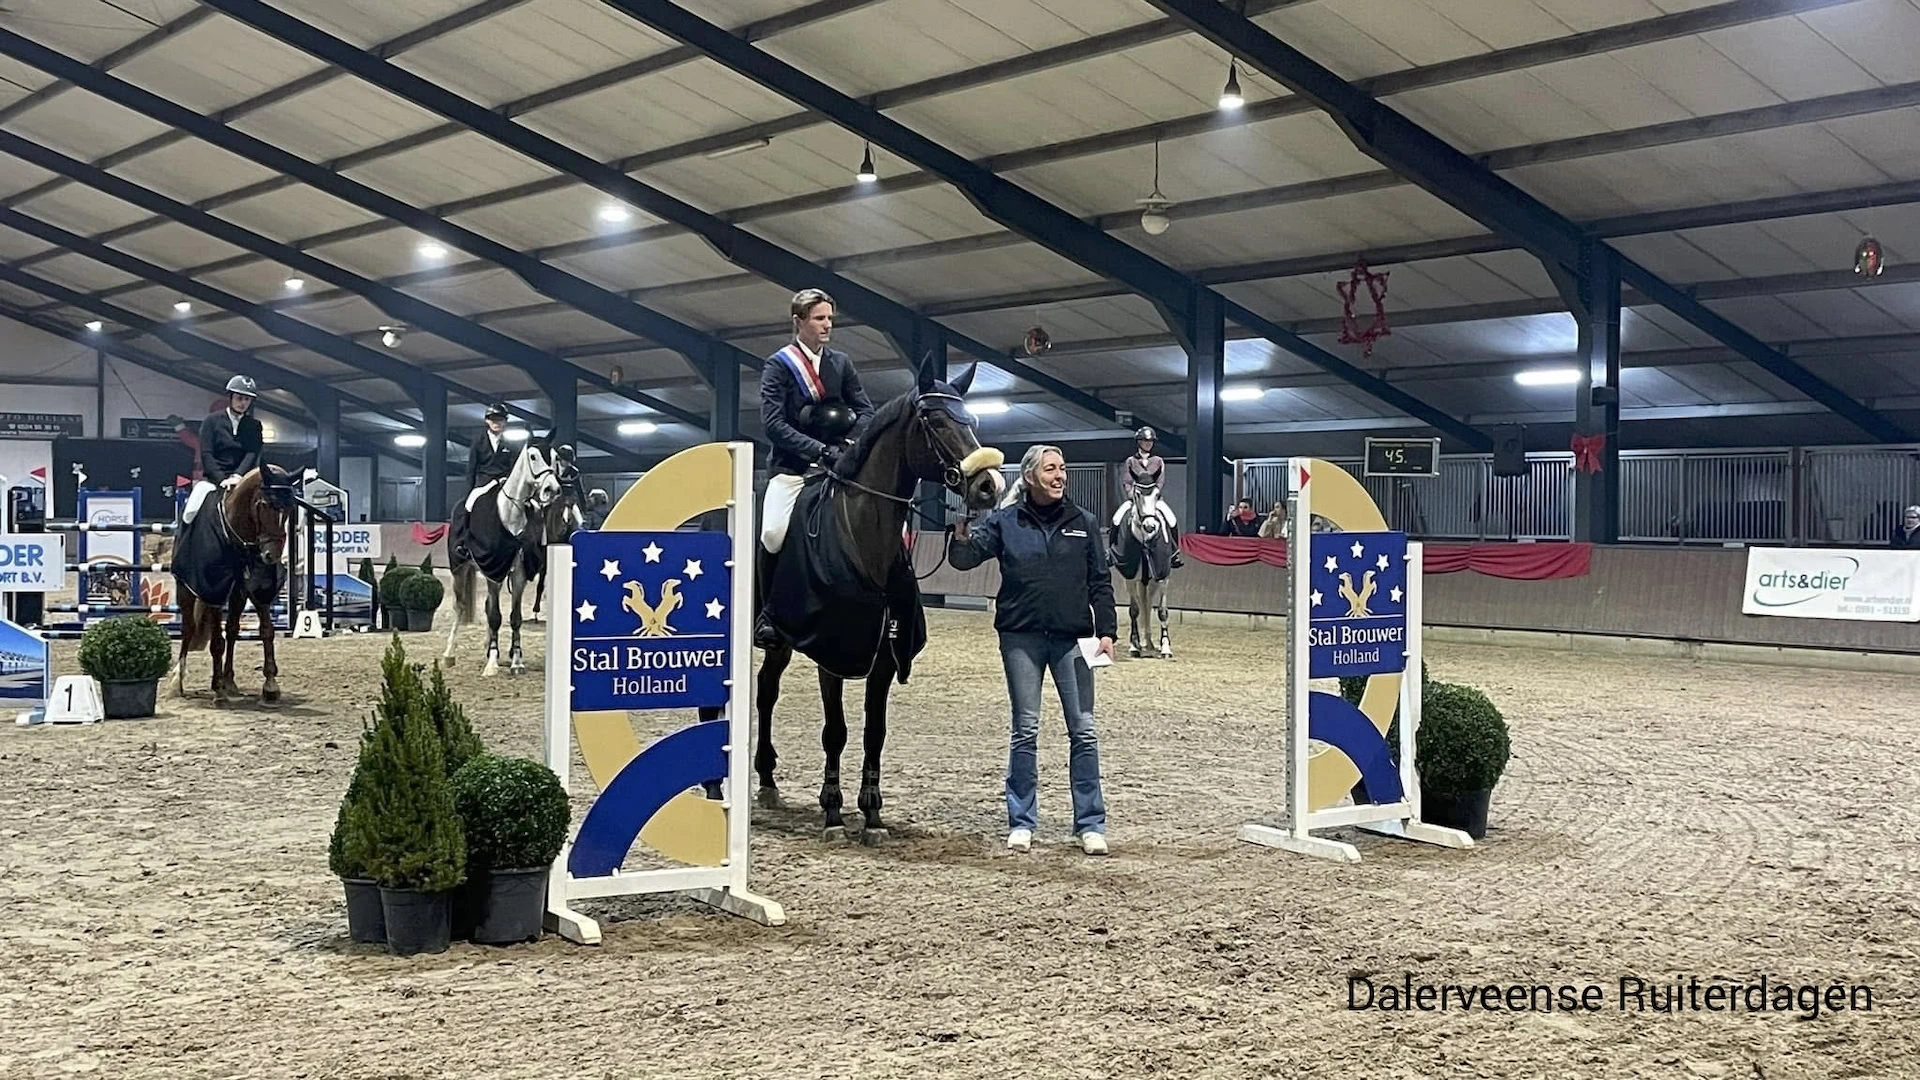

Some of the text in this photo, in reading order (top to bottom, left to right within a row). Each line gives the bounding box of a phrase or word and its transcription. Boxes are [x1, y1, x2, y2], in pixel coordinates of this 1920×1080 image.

[98, 515, 129, 524] HORSE
[21, 571, 45, 583] B.V.
[1759, 570, 1850, 590] arts&dier
[304, 616, 312, 632] 9
[1308, 625, 1404, 647] Stal Brouwer
[573, 645, 725, 672] Stal Brouwer
[1333, 647, 1380, 665] Holland
[612, 674, 687, 695] Holland
[64, 683, 73, 712] 1
